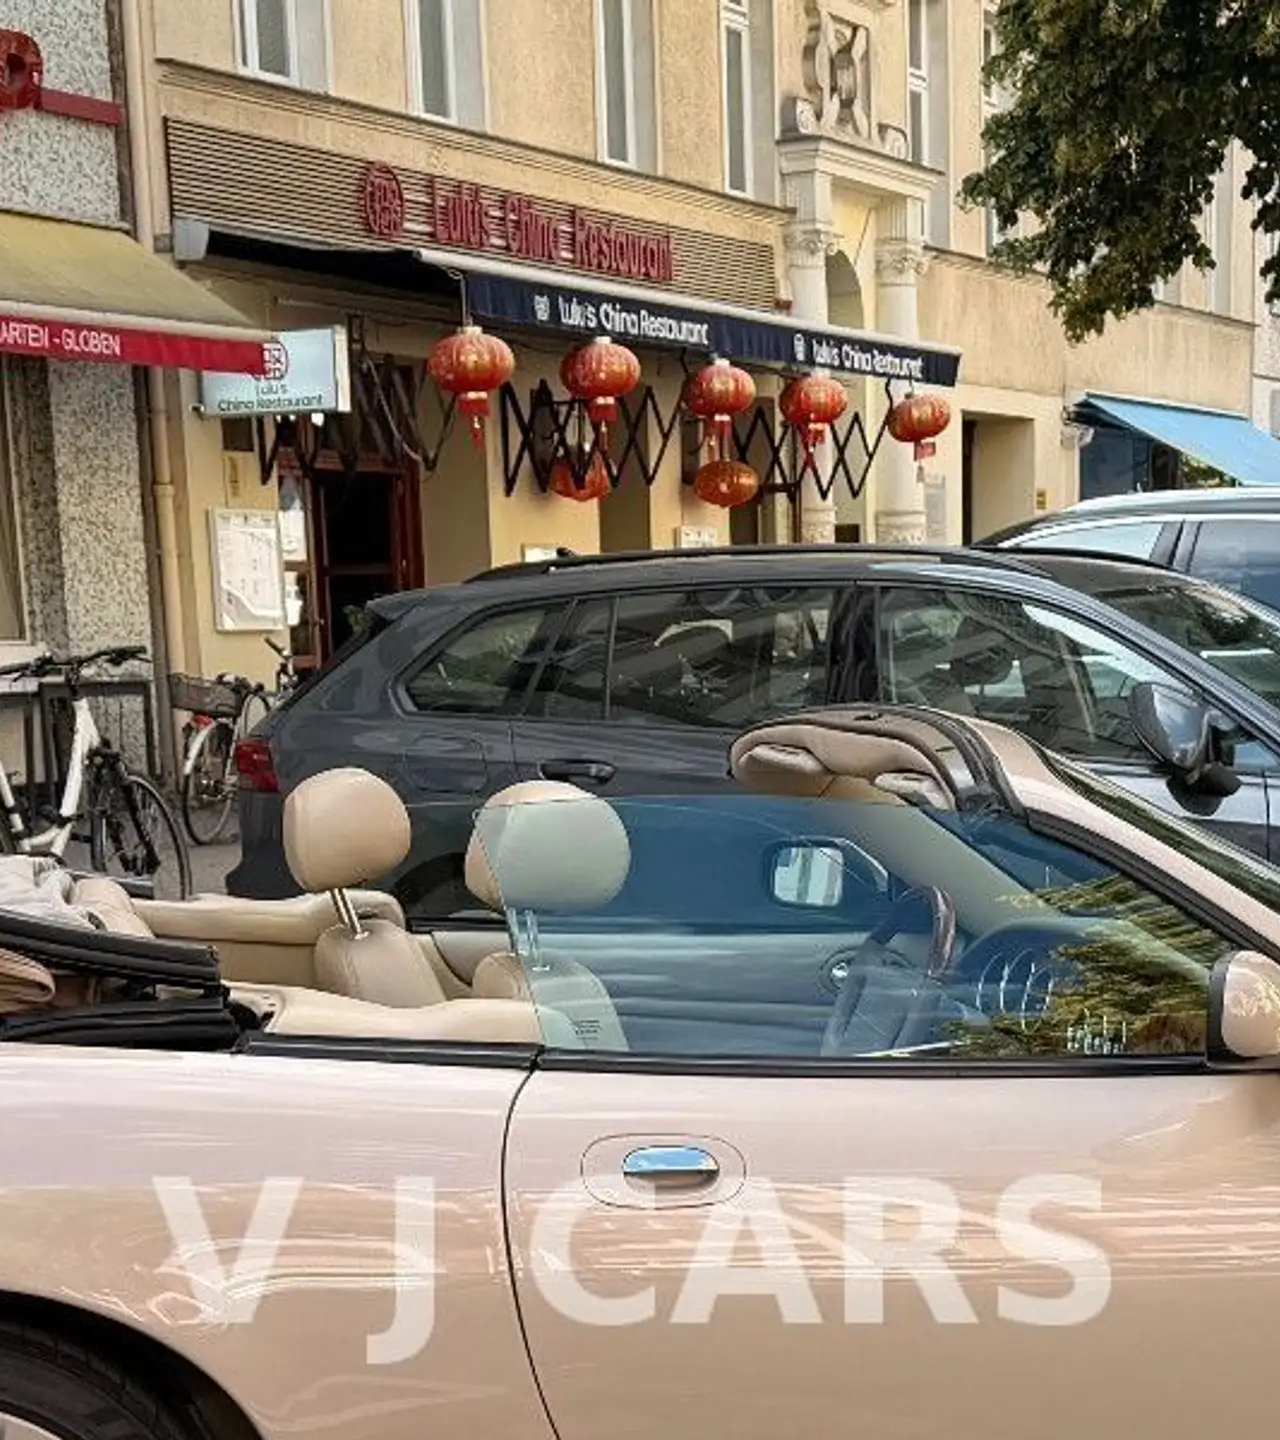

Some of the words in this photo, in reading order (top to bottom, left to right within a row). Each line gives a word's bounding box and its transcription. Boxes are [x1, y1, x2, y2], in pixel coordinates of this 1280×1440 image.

[572, 205, 673, 281] Restaurant
[558, 295, 598, 328] Lulu's
[599, 301, 639, 335] China
[640, 309, 709, 345] Restaurant
[61, 328, 121, 357] GLOBEN
[217, 397, 254, 412] China
[256, 394, 322, 410] Restaurant
